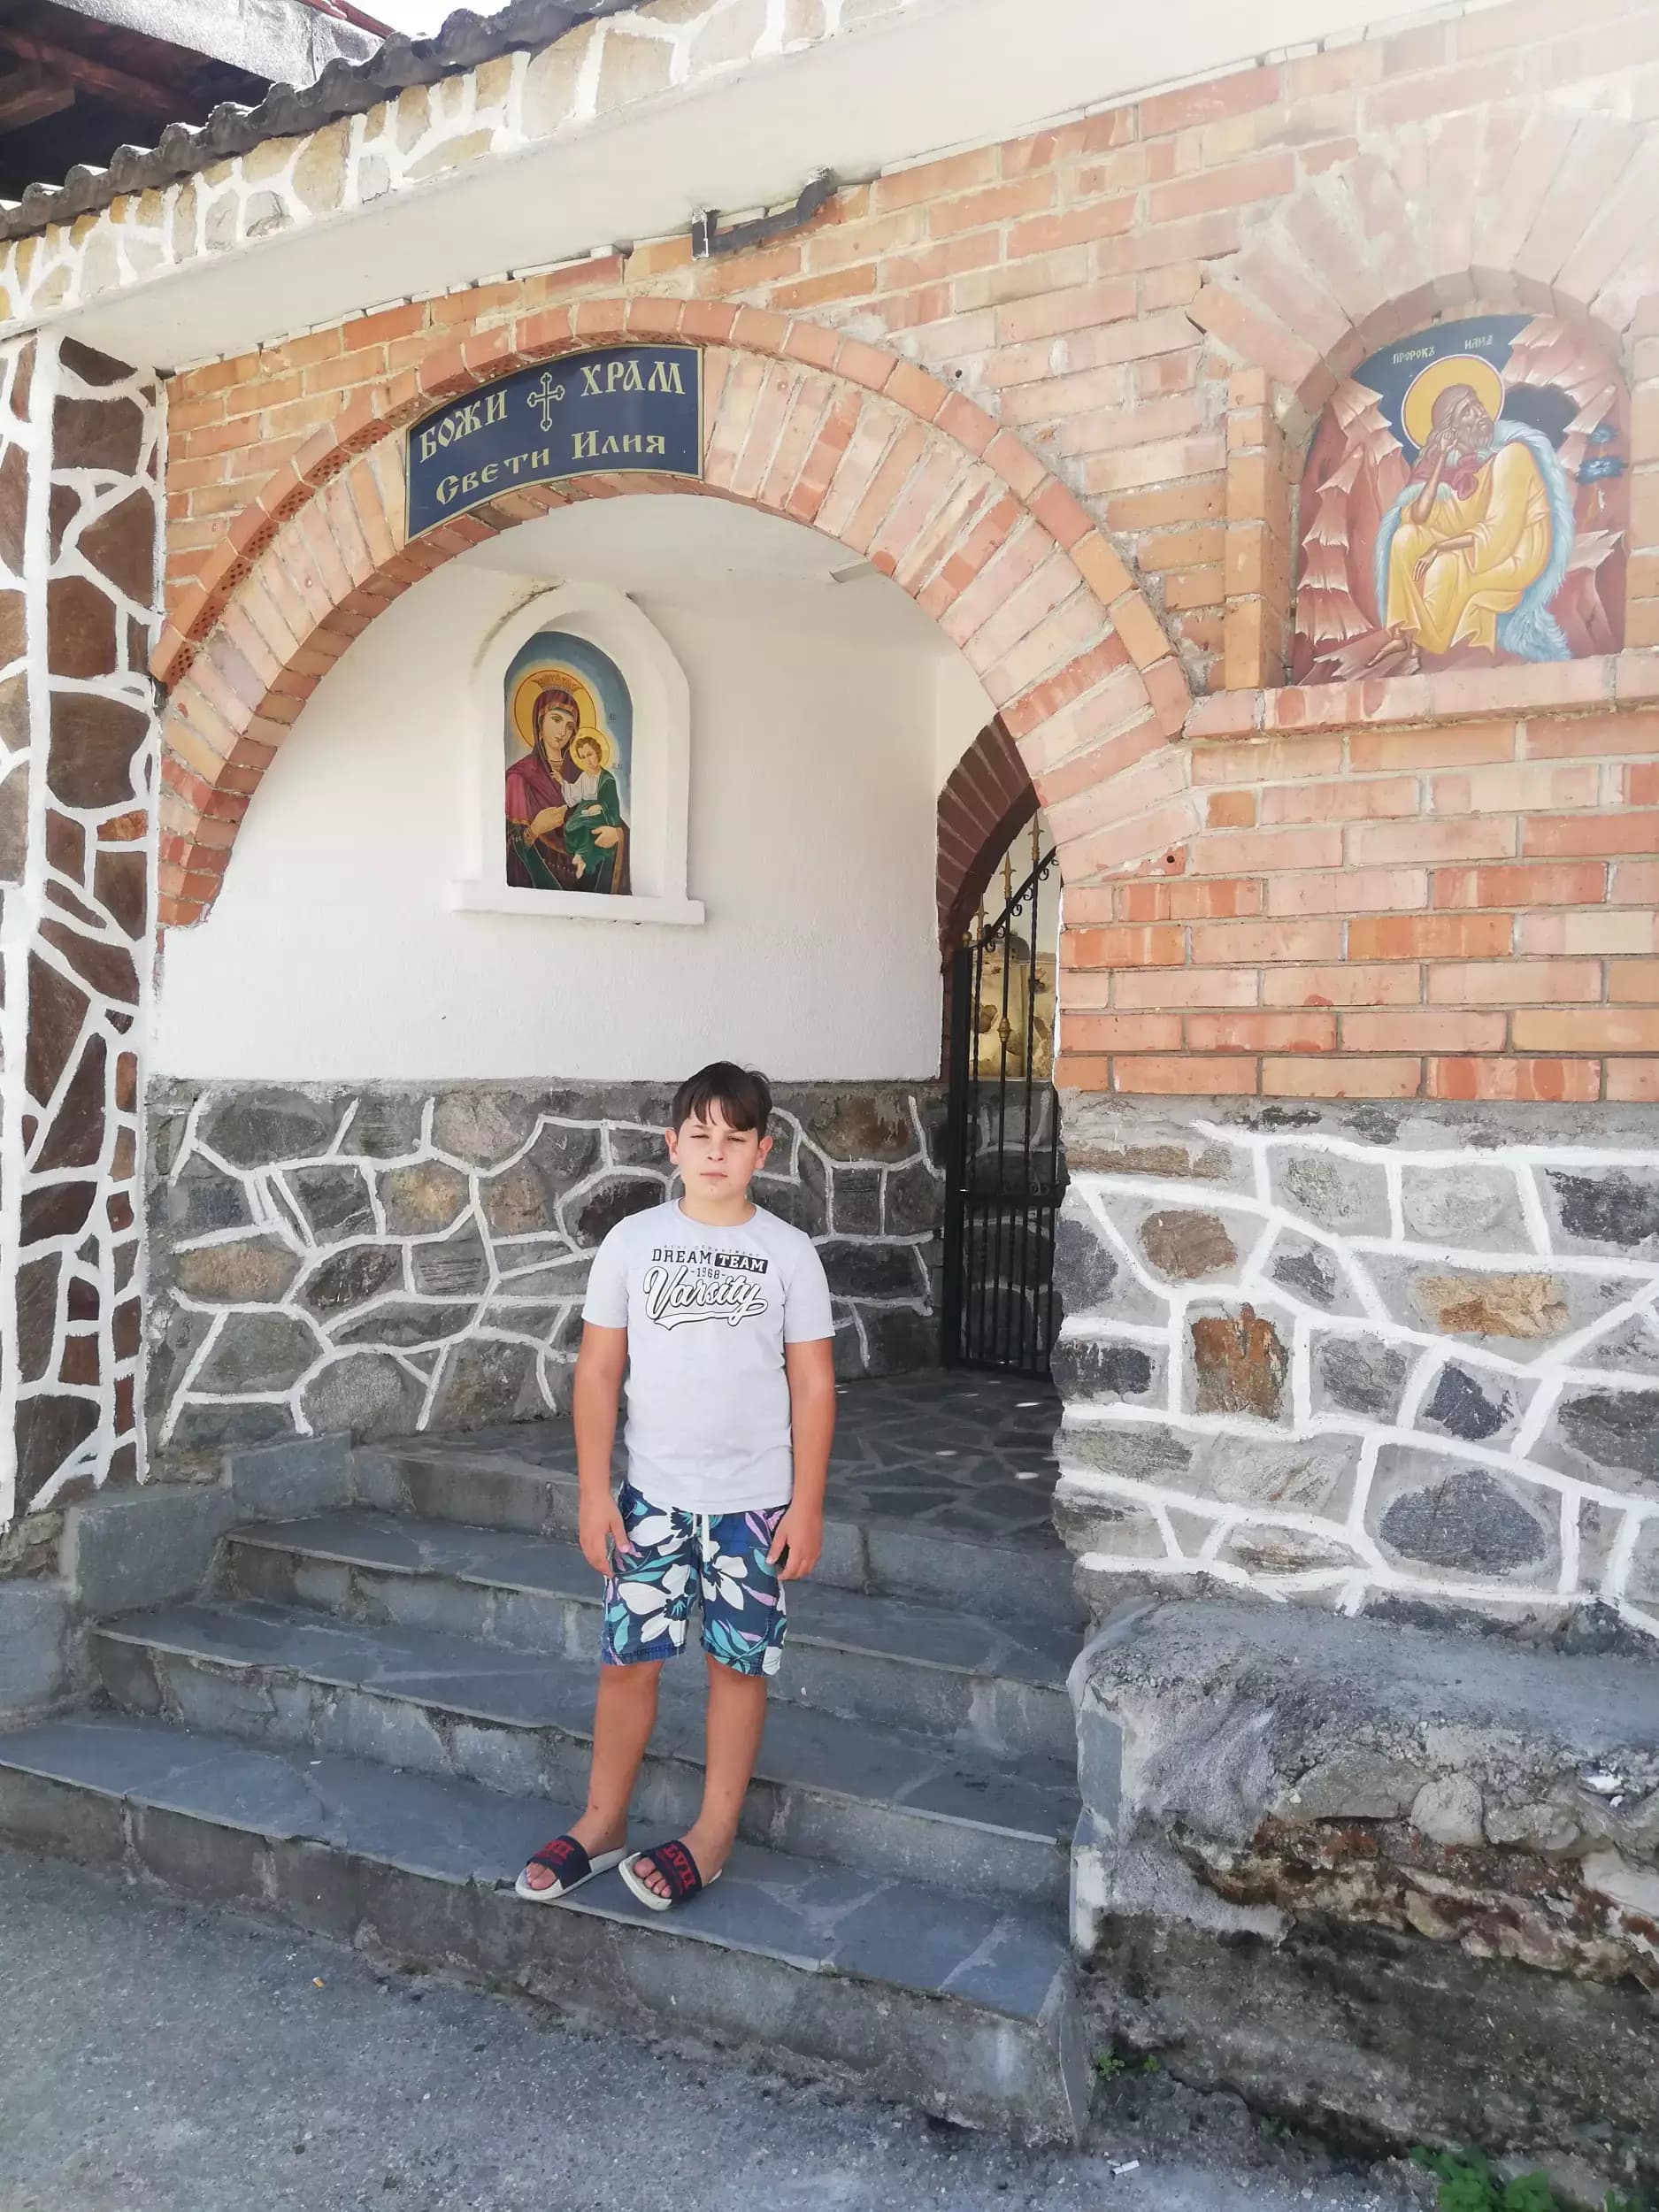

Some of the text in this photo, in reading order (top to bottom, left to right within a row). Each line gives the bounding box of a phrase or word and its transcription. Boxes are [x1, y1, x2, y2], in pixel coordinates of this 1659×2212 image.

[419, 360, 686, 464] БОЖИ ХРАМ
[651, 1248, 712, 1264] DREAM
[718, 1254, 766, 1273] TEAM
[643, 1265, 769, 1328] Varsity
